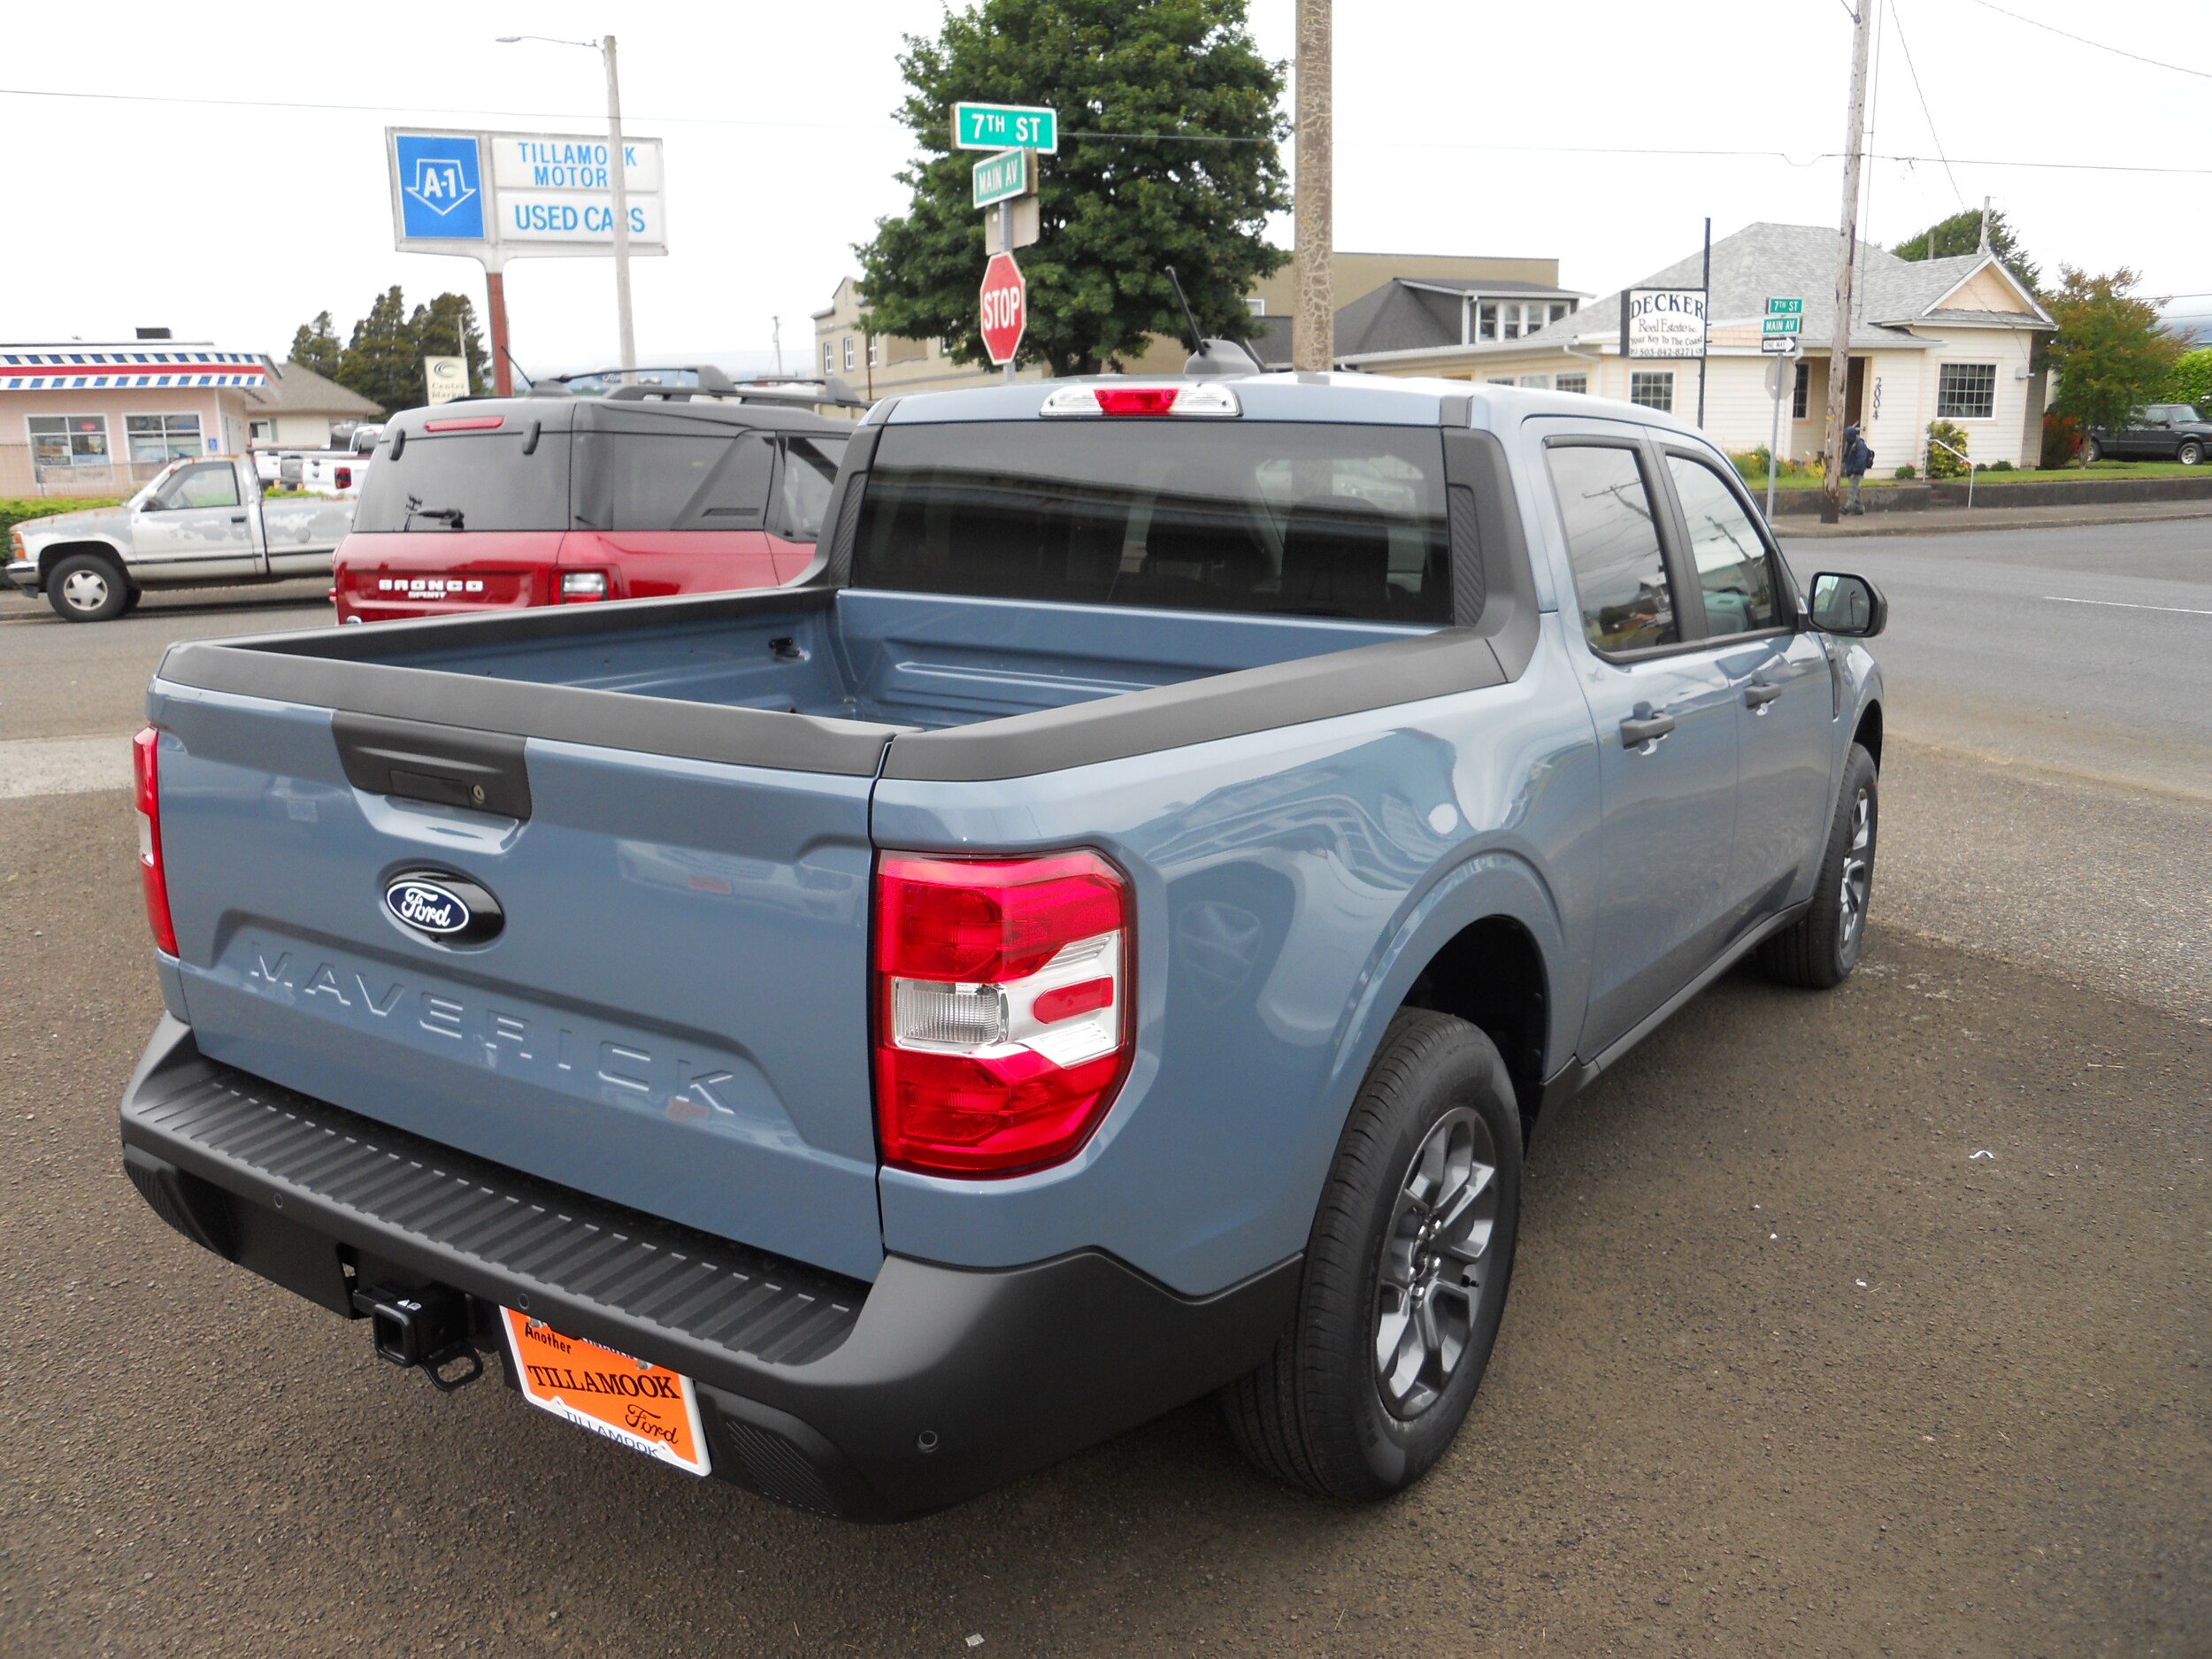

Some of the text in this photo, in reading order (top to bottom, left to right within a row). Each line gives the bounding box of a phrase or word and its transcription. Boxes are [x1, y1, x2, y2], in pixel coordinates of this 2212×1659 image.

[972, 113, 1041, 142] 7TH ST
[518, 142, 637, 166] TILLAMOK
[424, 167, 457, 198] A-1
[534, 166, 608, 188] MOTOR
[979, 158, 1018, 196] MAIN AV
[516, 204, 646, 233] USED CAS
[983, 286, 1021, 331] STOP
[1631, 294, 1704, 320] DECKER
[1788, 301, 1798, 311] ST
[1638, 319, 1660, 333] Real
[1661, 319, 1687, 333] Estate
[1766, 319, 1795, 331] MAIN AV
[1647, 335, 1659, 344] Key
[1671, 336, 1683, 345] The
[1685, 335, 1703, 346] Coast
[1872, 377, 1882, 420] 2004
[379, 580, 484, 592] BRONCO
[402, 887, 451, 926] Ford
[250, 941, 735, 1115] MAVERICK
[525, 1322, 572, 1355] Another
[528, 1365, 680, 1400] TILLAMOOK
[564, 1409, 658, 1458] TILLAMOOK
[625, 1404, 679, 1444] Ford
